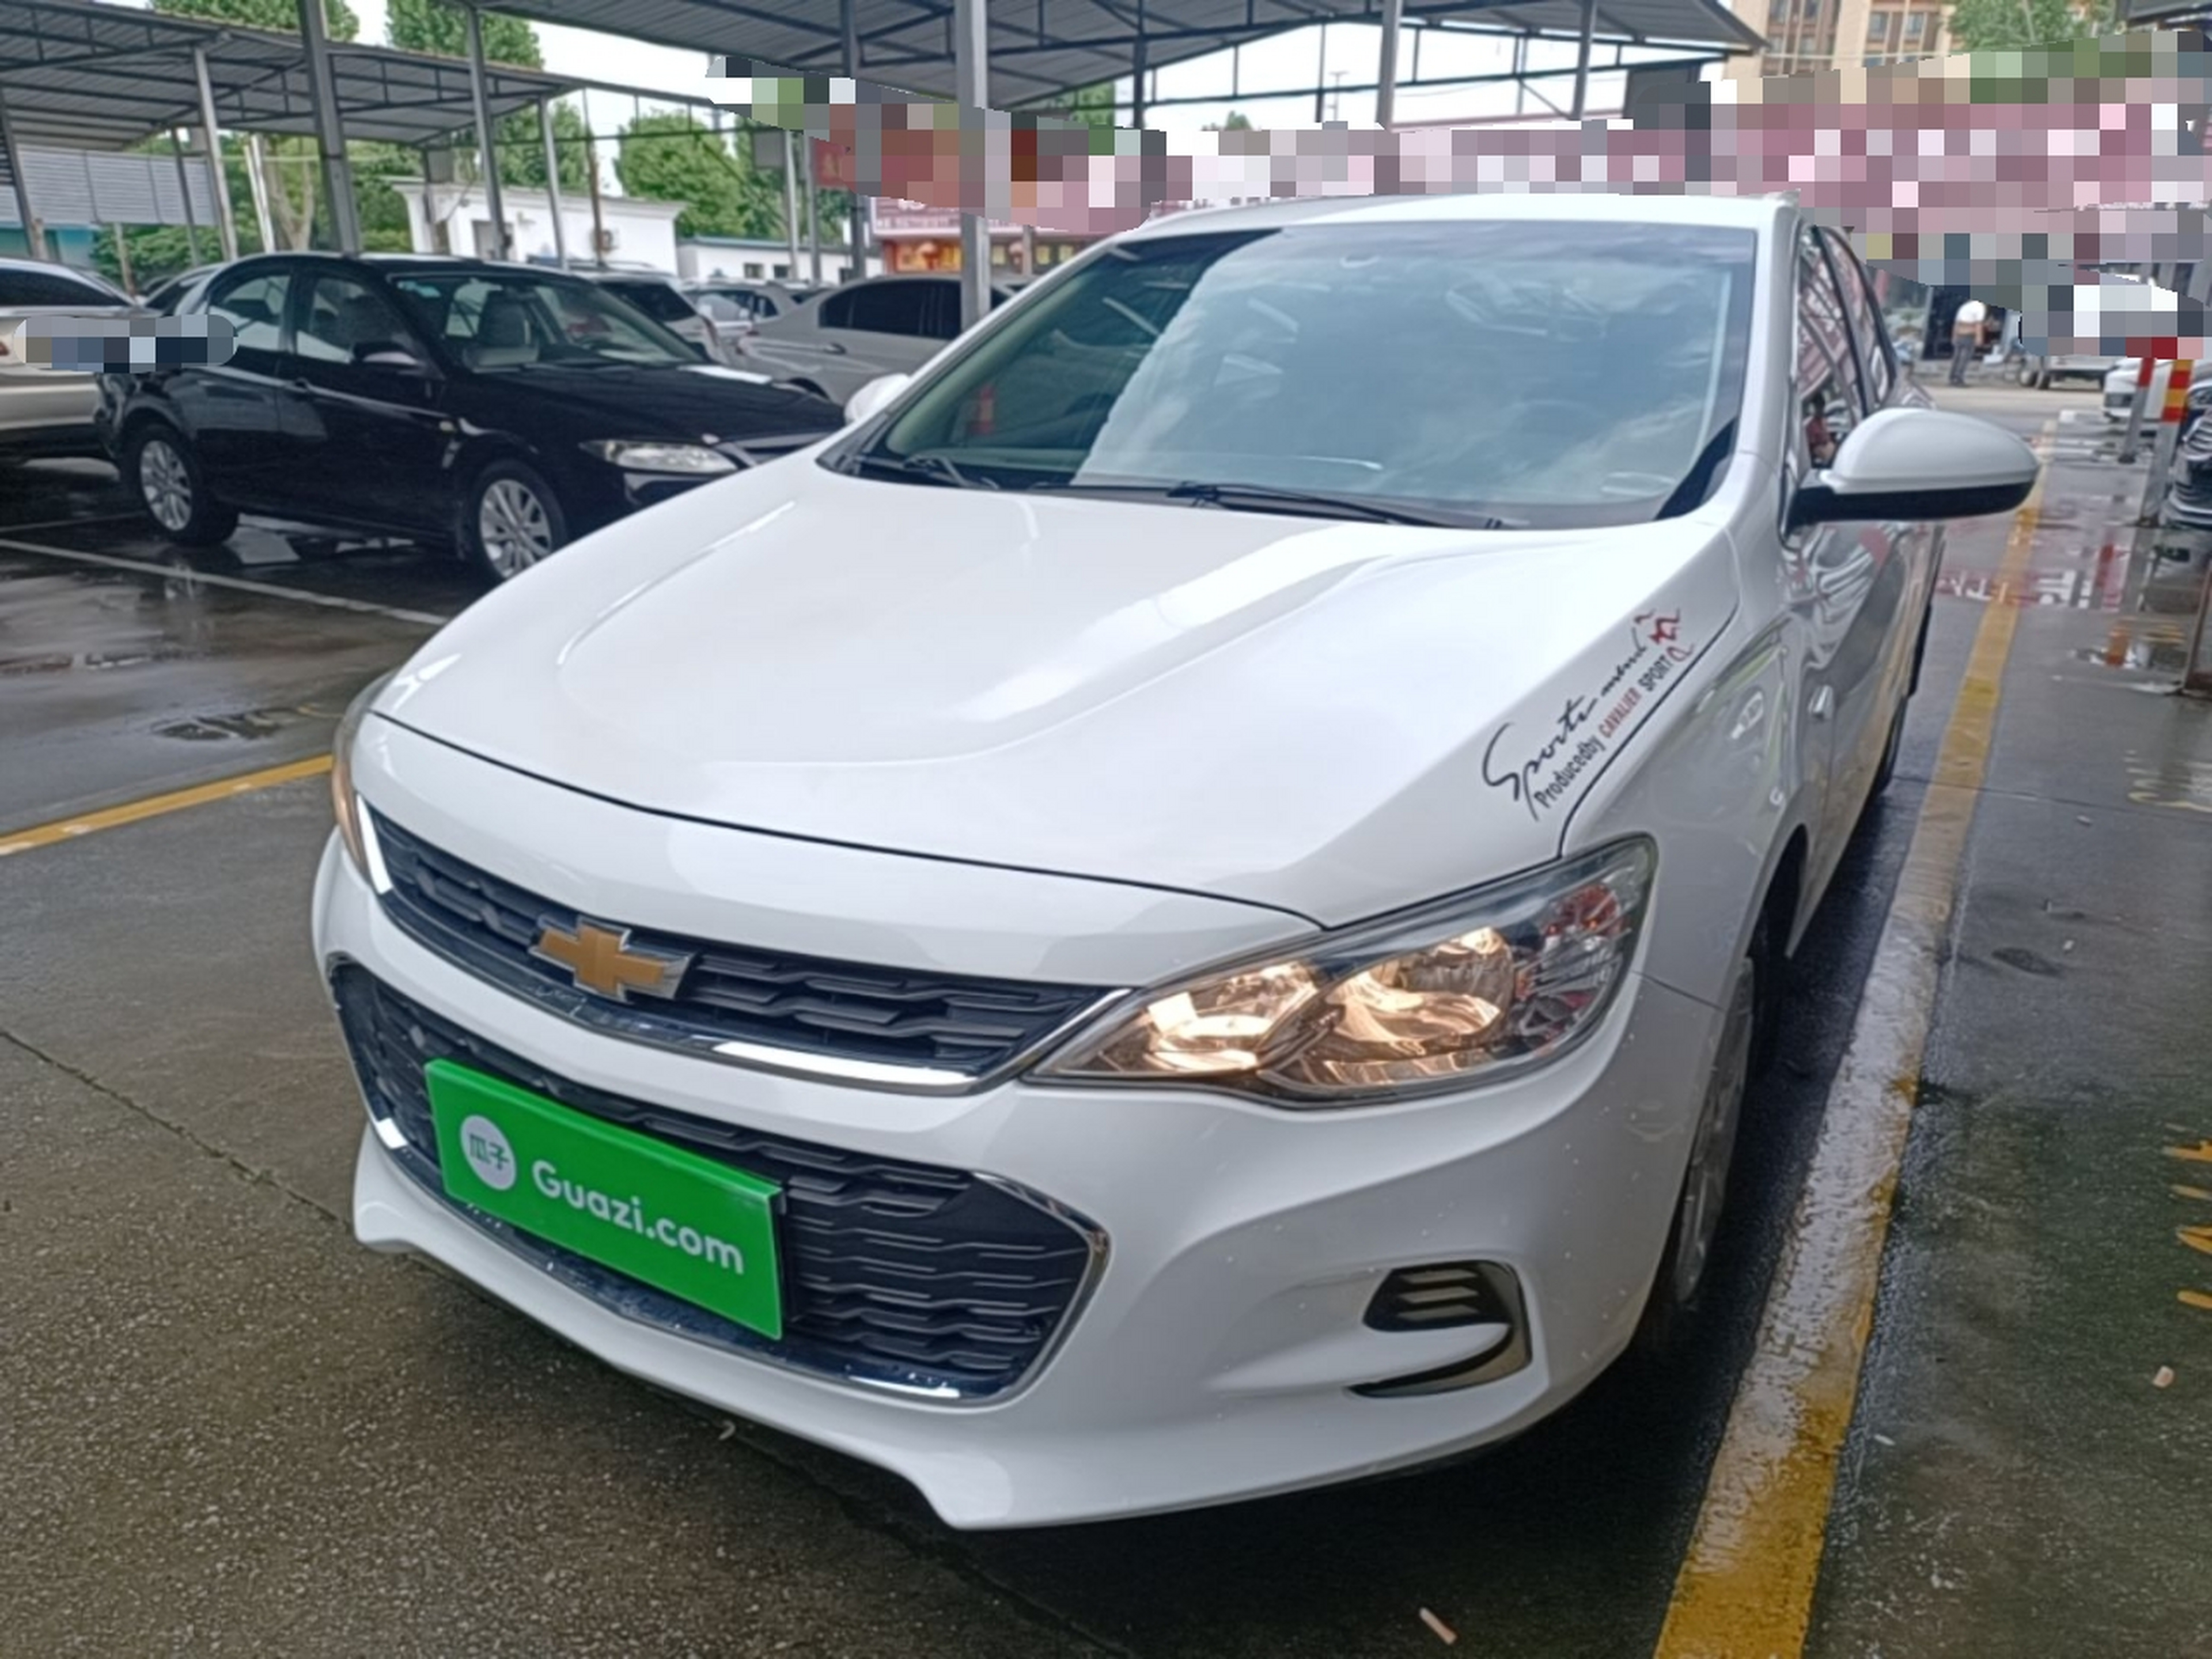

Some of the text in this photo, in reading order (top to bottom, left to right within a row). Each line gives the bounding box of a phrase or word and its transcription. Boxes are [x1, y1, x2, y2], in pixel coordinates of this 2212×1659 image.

[1598, 687, 1642, 738] CAVALIER
[1638, 654, 1673, 692] SPORT
[469, 1132, 510, 1171] 瓜子
[532, 1160, 744, 1275] Guazi.com
